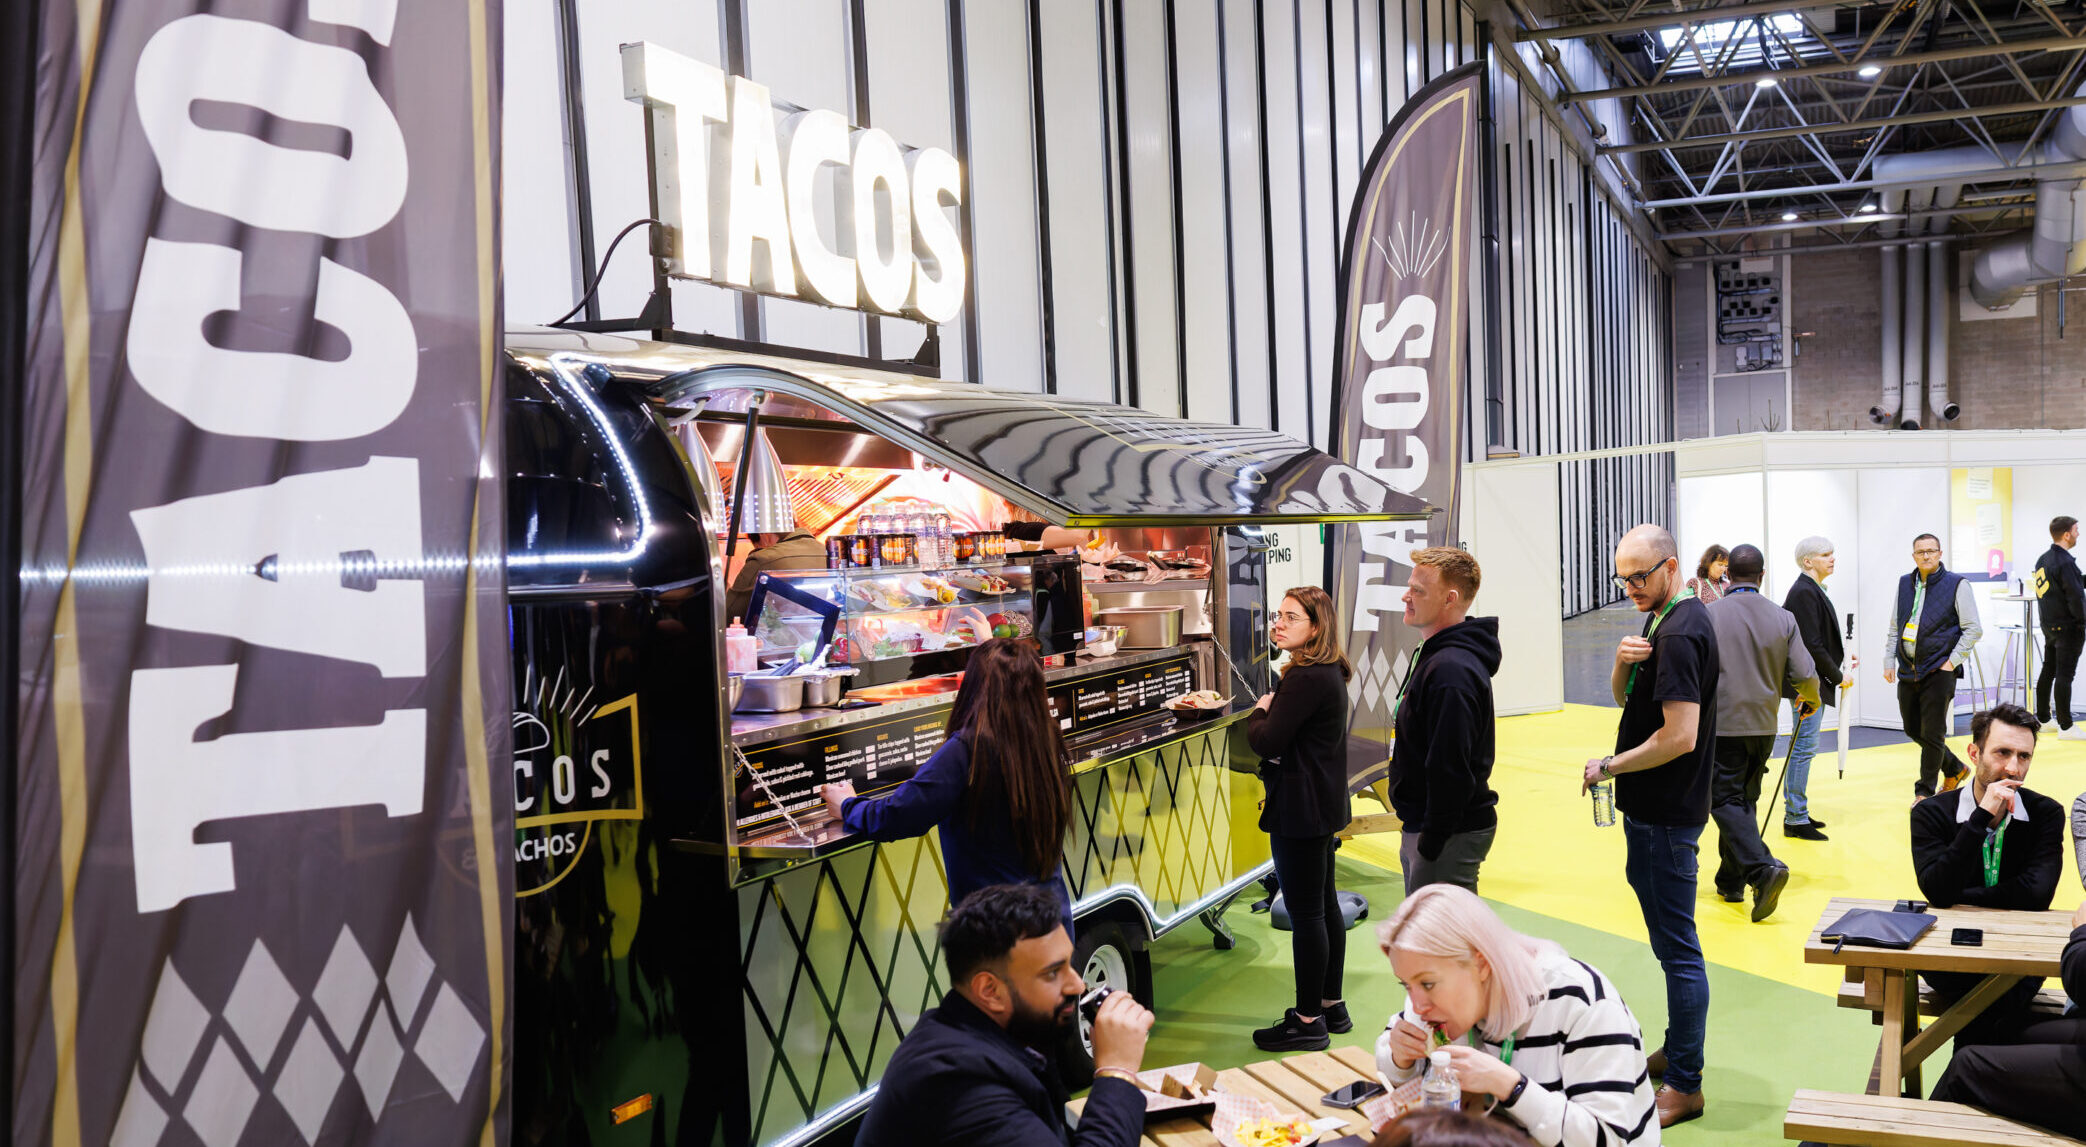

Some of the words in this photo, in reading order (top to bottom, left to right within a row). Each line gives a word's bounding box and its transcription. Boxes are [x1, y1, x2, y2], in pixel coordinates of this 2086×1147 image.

[622, 40, 966, 323] TACOS
[127, 0, 427, 914] TACO
[1265, 532, 1279, 548] NG
[1267, 547, 1292, 565] PING
[513, 749, 611, 812] COS
[515, 832, 576, 863] CHOS
